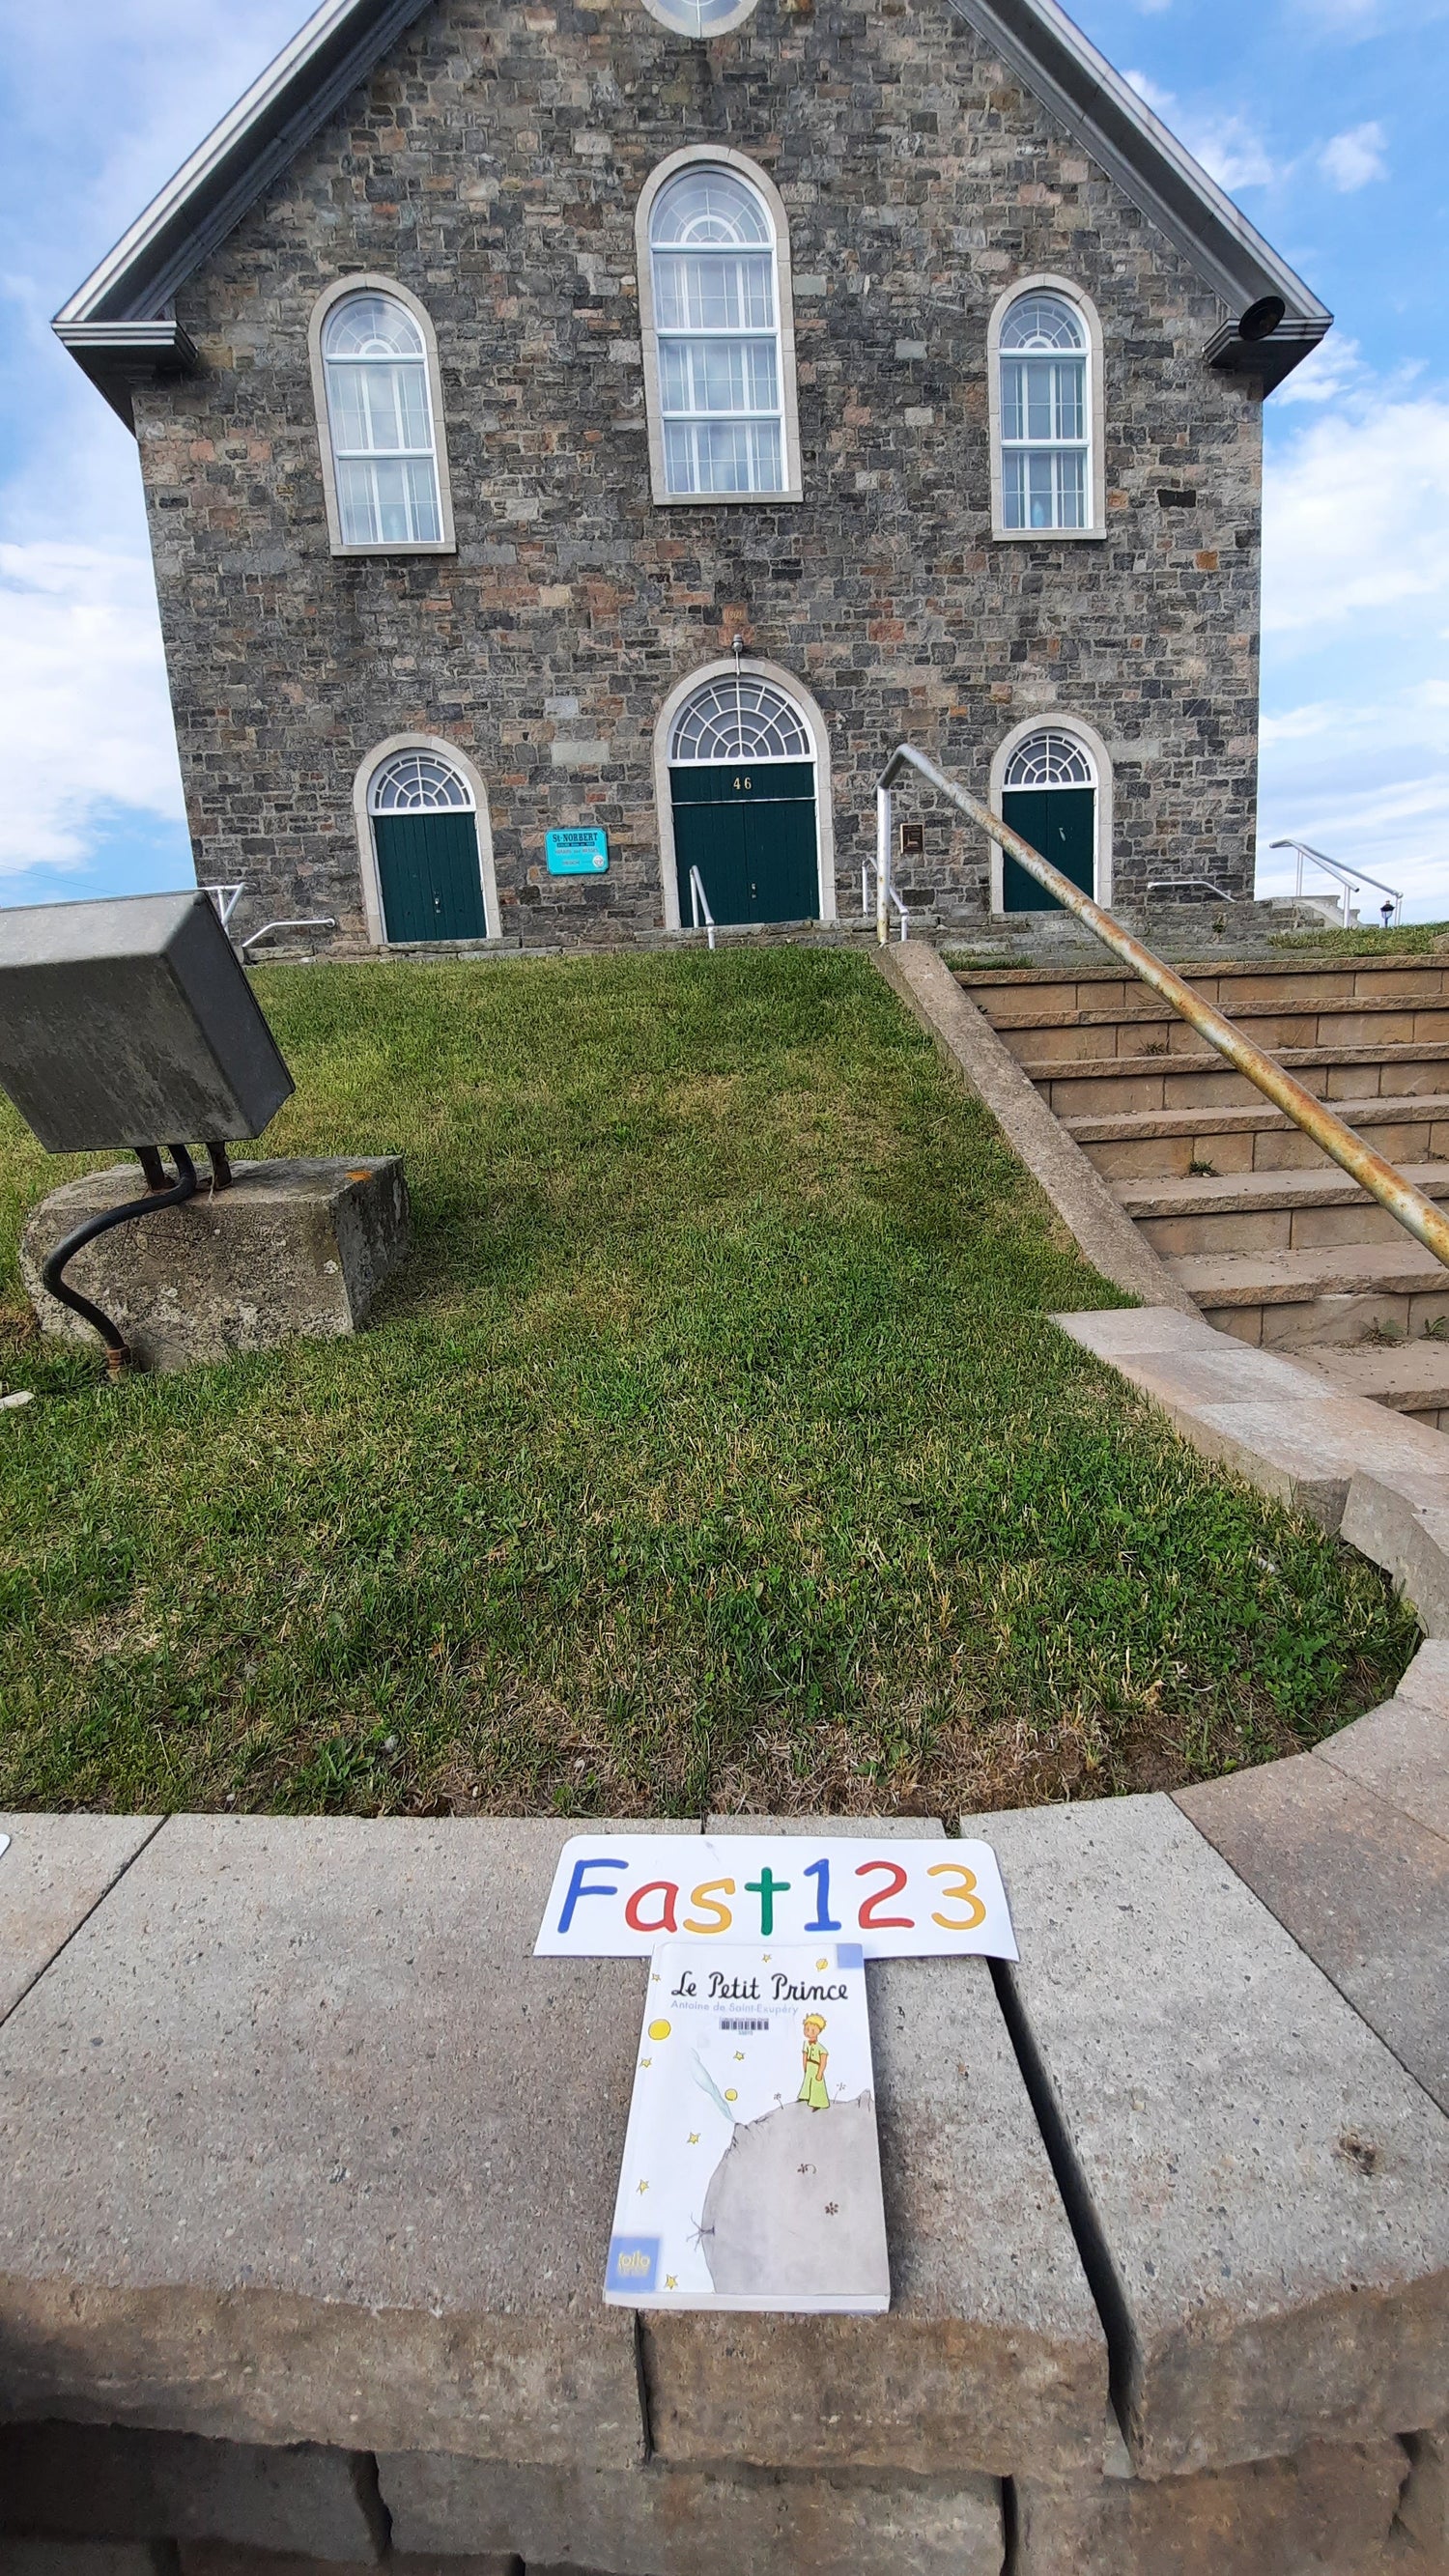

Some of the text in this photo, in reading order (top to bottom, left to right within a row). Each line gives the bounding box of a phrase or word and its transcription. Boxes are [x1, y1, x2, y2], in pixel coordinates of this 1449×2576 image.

[733, 777, 752, 790] 46
[556, 1857, 987, 1936] Fast123
[671, 1970, 848, 2000] Le Petit Prince
[670, 1999, 800, 2016] Antoine de Saint-Exupéry
